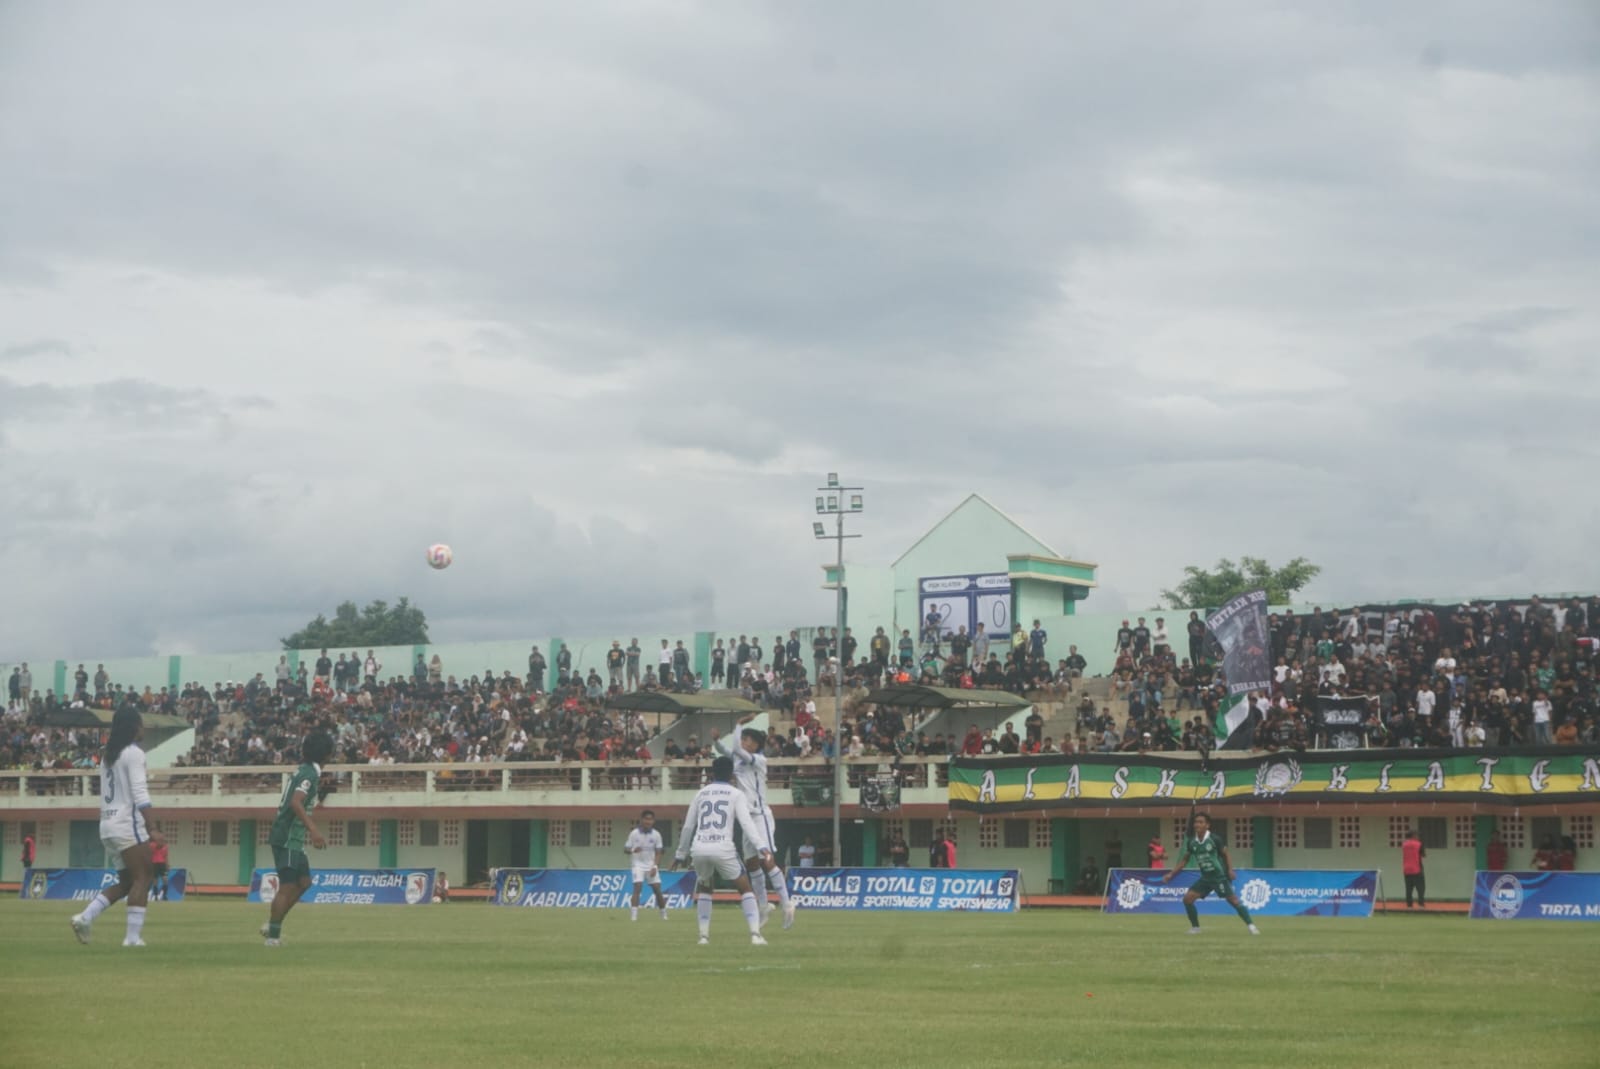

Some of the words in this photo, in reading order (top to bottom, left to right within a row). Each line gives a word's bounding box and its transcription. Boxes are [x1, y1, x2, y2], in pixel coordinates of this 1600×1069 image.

[939, 602, 953, 630] 2
[993, 600, 1006, 628] 0
[699, 800, 729, 831] 25
[320, 874, 354, 886] JAWA
[357, 874, 403, 888] TENGAH
[589, 874, 627, 892] PSSI
[792, 876, 843, 893] TOTAL
[866, 877, 915, 893] TOTAL
[941, 878, 994, 895] TOTAL
[314, 892, 376, 904] 2025/2026
[523, 892, 621, 908] KABUPATEN
[620, 892, 692, 909] KAEN
[790, 895, 858, 907] SPORTSWEAR
[1286, 888, 1318, 897] BONJOR
[1318, 888, 1339, 898] JAYA
[1339, 888, 1369, 897] UTAMA
[863, 895, 932, 908] SPORTSWEAR
[937, 896, 1010, 910] SPORTSWEAR
[1540, 904, 1582, 916] TIRTA
[1584, 904, 1600, 917] M
